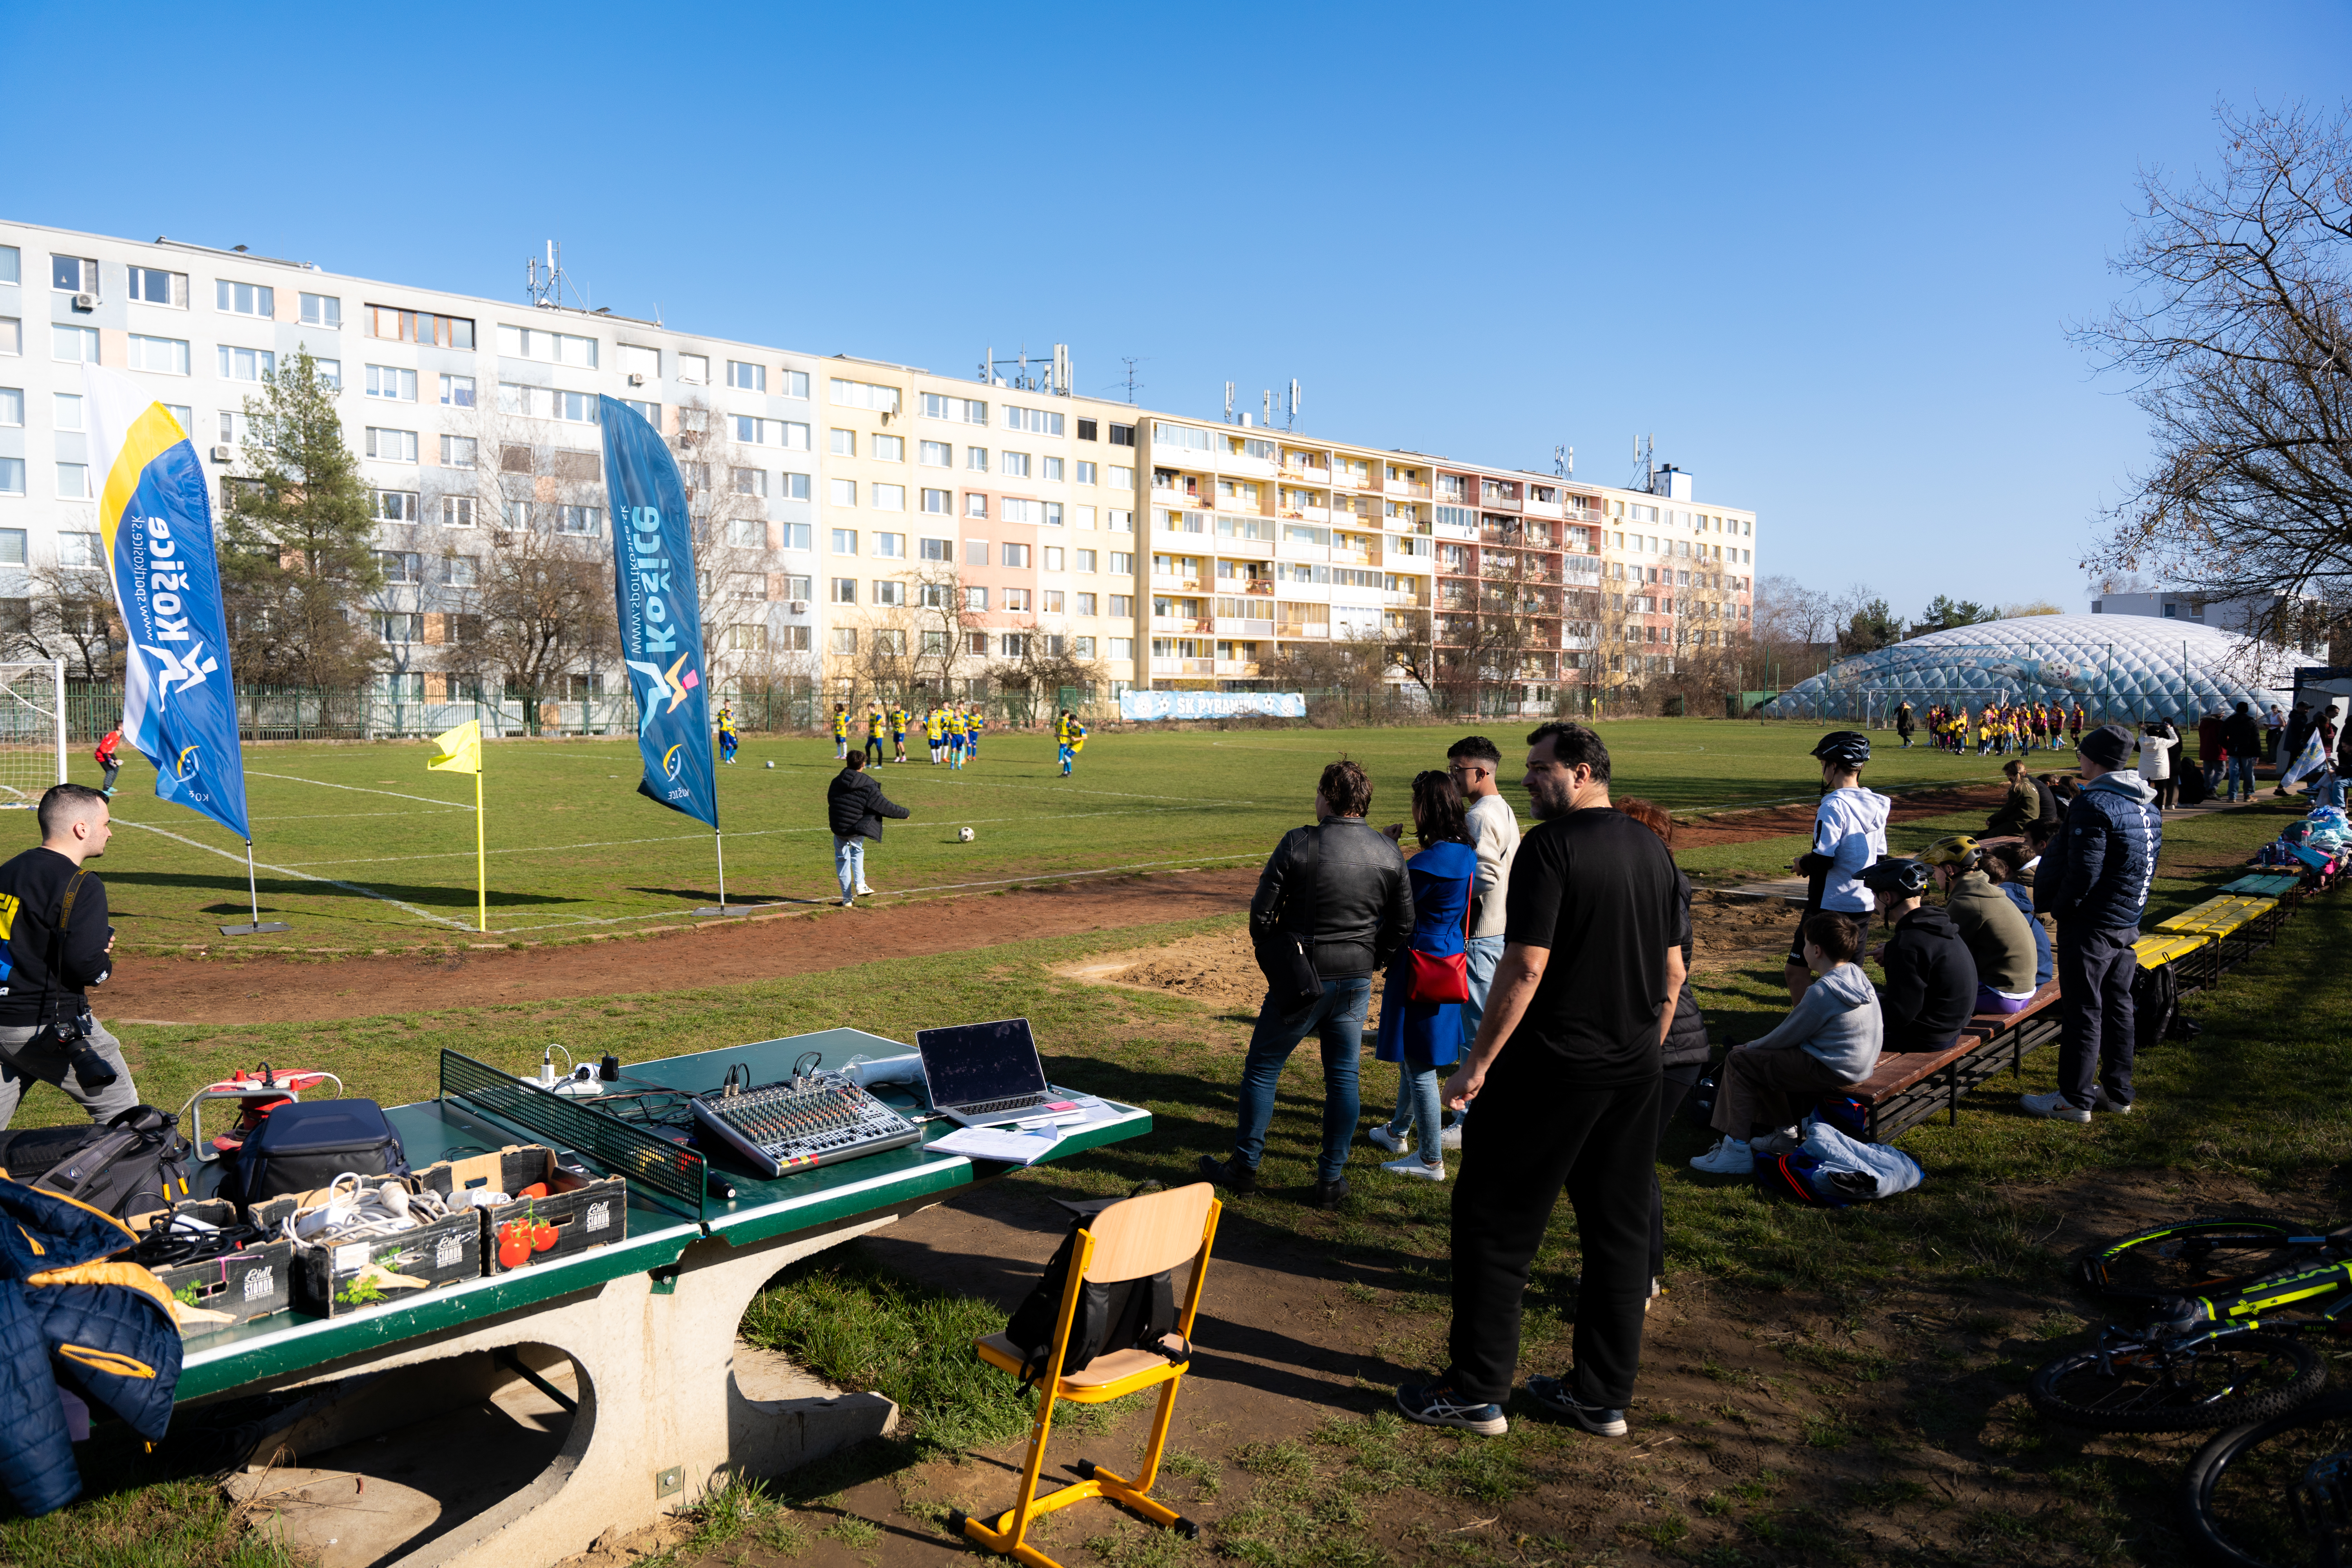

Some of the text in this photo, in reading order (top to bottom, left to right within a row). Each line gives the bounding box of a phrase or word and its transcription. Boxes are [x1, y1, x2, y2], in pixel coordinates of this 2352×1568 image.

[1177, 693, 1195, 714] ŠK
[931, 721, 938, 730] 10
[64, 892, 75, 908] D600
[586, 1200, 609, 1216] Lidl
[2140, 1218, 2224, 1236] SCHWALBE
[436, 1234, 462, 1250] Lidl
[244, 1265, 273, 1283] Lidl
